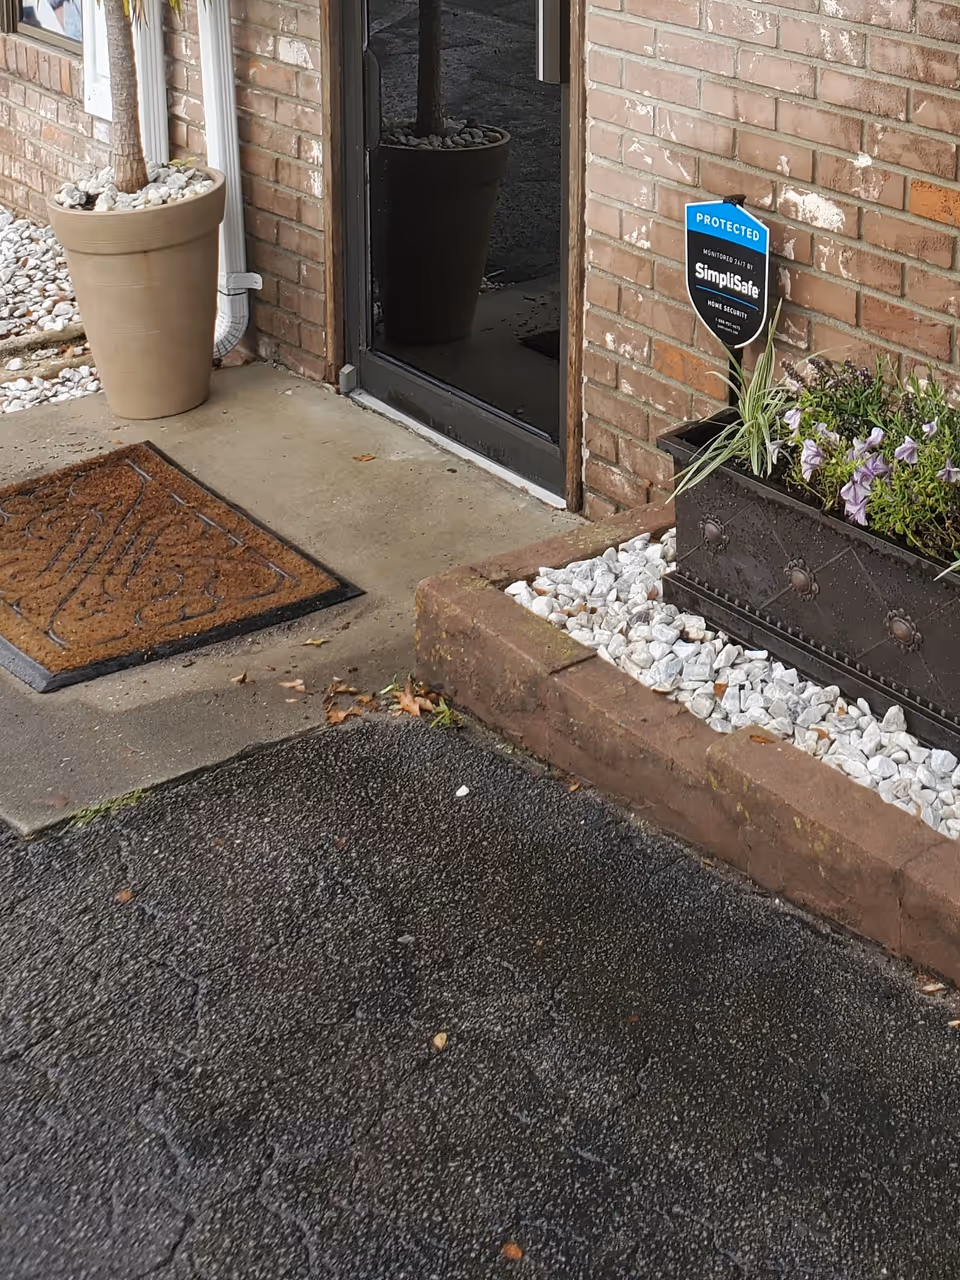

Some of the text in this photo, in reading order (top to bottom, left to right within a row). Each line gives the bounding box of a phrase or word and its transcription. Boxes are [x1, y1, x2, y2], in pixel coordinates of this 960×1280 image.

[696, 212, 760, 241] PROTECTED
[703, 248, 733, 263] MONITORED
[695, 261, 759, 298] SimpliSafe
[707, 299, 748, 319] HOME SECURITY
